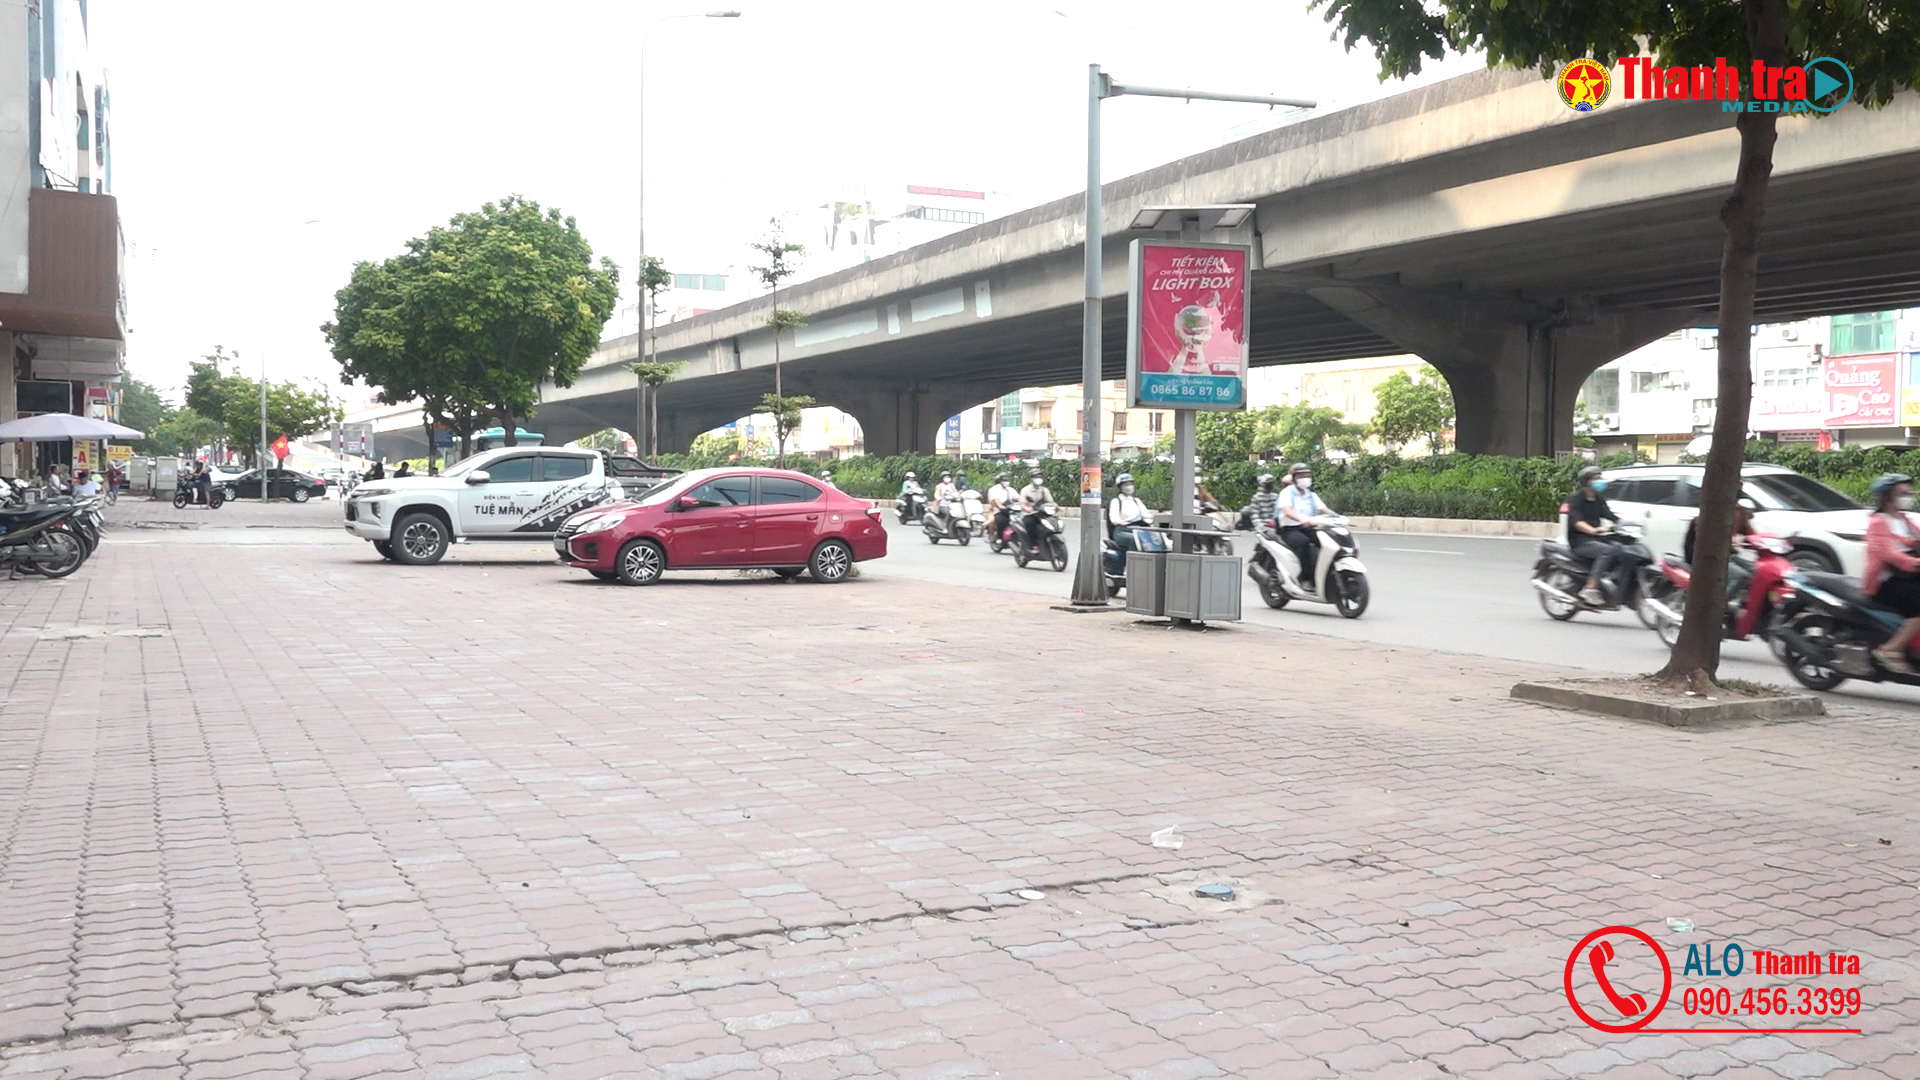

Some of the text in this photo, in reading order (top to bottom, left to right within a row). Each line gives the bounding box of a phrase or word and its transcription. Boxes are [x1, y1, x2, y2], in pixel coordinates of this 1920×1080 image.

[1152, 276, 1235, 291] LIGHT BOX
[1825, 365, 1881, 387] Quảng
[1151, 384, 1231, 397] 0865 86 87 86
[1858, 388, 1891, 405] Cáo
[474, 503, 495, 517] TUỆ
